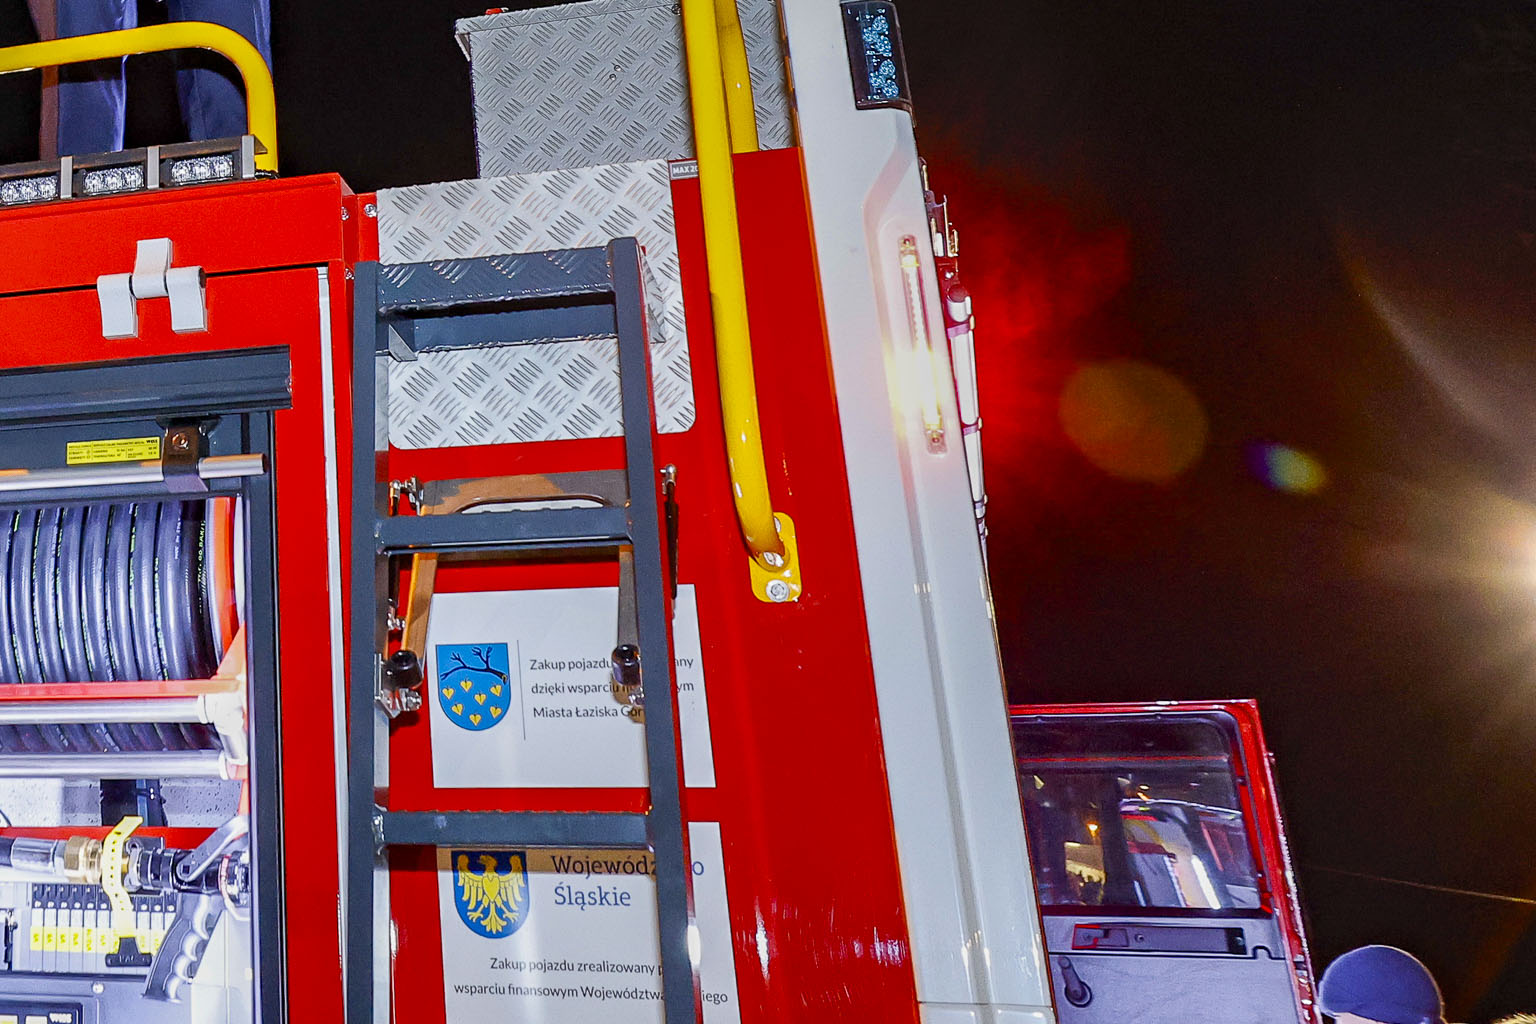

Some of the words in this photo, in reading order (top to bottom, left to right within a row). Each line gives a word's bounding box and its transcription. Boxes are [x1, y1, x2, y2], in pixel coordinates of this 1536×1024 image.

[672, 165, 689, 174] MAX
[530, 658, 566, 671] Zakup
[531, 682, 567, 696] dzięki
[567, 682, 619, 695] wsparciu
[533, 706, 573, 718] Miasta
[575, 705, 618, 718] Łaziska
[554, 881, 631, 910] Śląskie
[490, 957, 526, 972] Zakup
[529, 959, 574, 973] pojazdu
[577, 960, 655, 976] zrealizowany
[453, 983, 505, 995] wsparciu
[508, 983, 578, 999] finansowym
